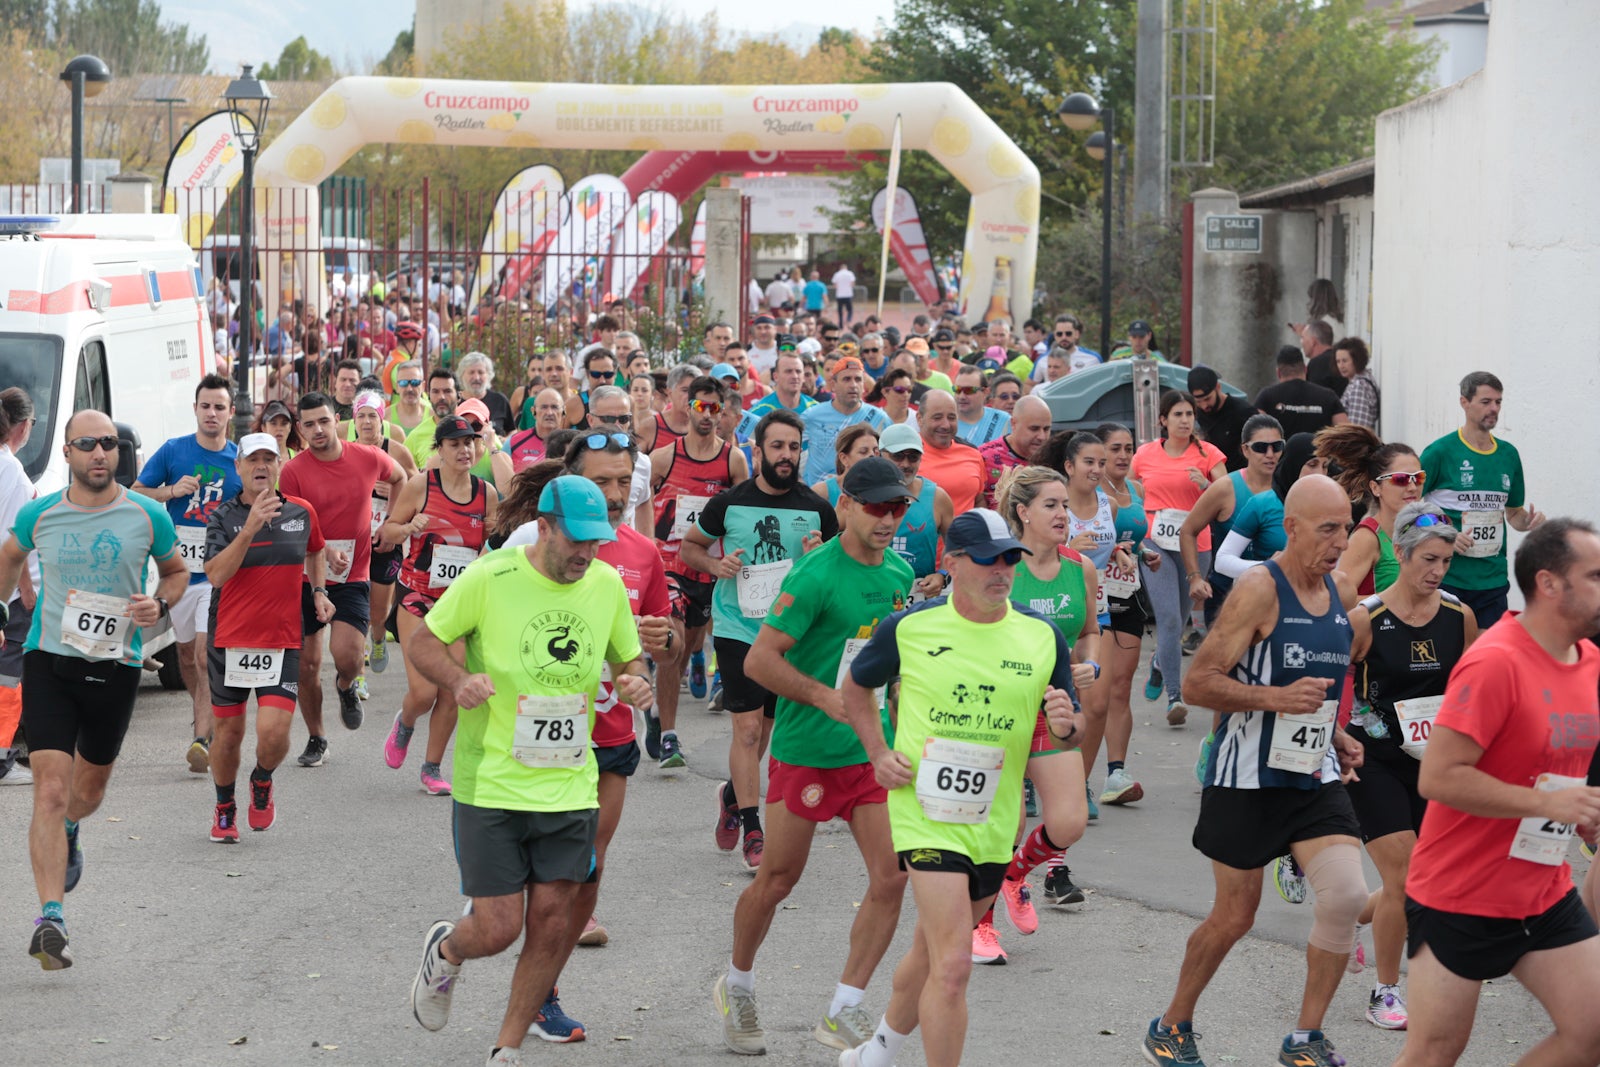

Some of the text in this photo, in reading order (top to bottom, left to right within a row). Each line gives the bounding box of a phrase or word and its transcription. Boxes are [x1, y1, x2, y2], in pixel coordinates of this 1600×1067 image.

[424, 91, 530, 112] Cruzcampo
[753, 96, 859, 113] Cruzcampo
[434, 113, 486, 132] Radler
[556, 118, 723, 132] DOBLEMENTE REFRESCANTE
[763, 118, 814, 136] Radler
[182, 133, 231, 191] Cruzcampo
[1224, 219, 1255, 228] CALLE
[1458, 494, 1481, 502] CAJA
[62, 533, 82, 547] IX
[1473, 526, 1496, 540] 582
[61, 573, 121, 585] ROMANA
[78, 612, 117, 636] 676
[530, 612, 586, 634] BAR SORIA
[239, 654, 272, 670] 449
[929, 707, 972, 727] Carmen
[976, 714, 985, 730] y
[534, 718, 574, 741] 783
[1291, 726, 1326, 749] 470
[937, 767, 986, 795] 659
